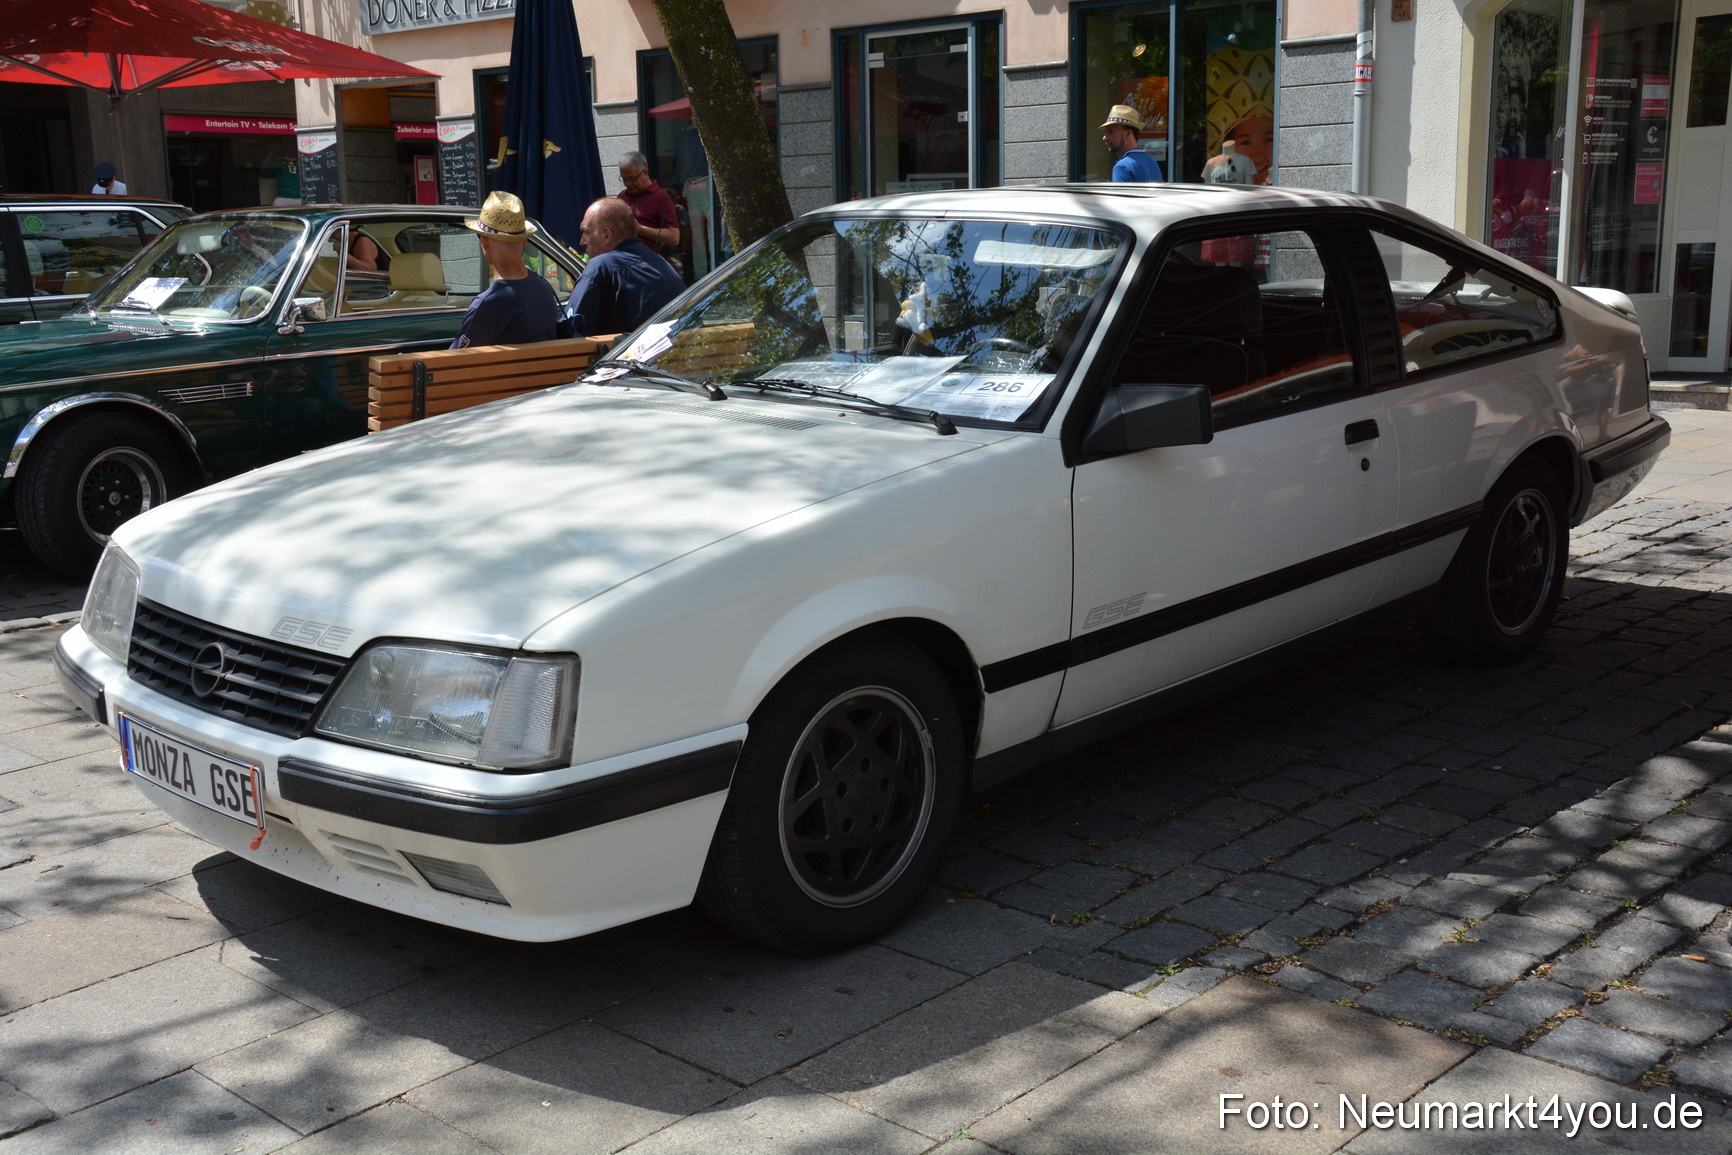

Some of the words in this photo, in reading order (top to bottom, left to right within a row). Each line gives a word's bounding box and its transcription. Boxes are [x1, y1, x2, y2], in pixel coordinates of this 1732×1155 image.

[205, 120, 239, 128] Entertain
[258, 121, 288, 130] Telekom
[397, 125, 422, 134] Zubehör
[288, 165, 297, 174] 13
[977, 381, 1025, 393] 286
[1084, 592, 1147, 630] GSE
[271, 616, 354, 650] GSE
[132, 728, 195, 796] MONZA
[211, 764, 255, 818] GSE
